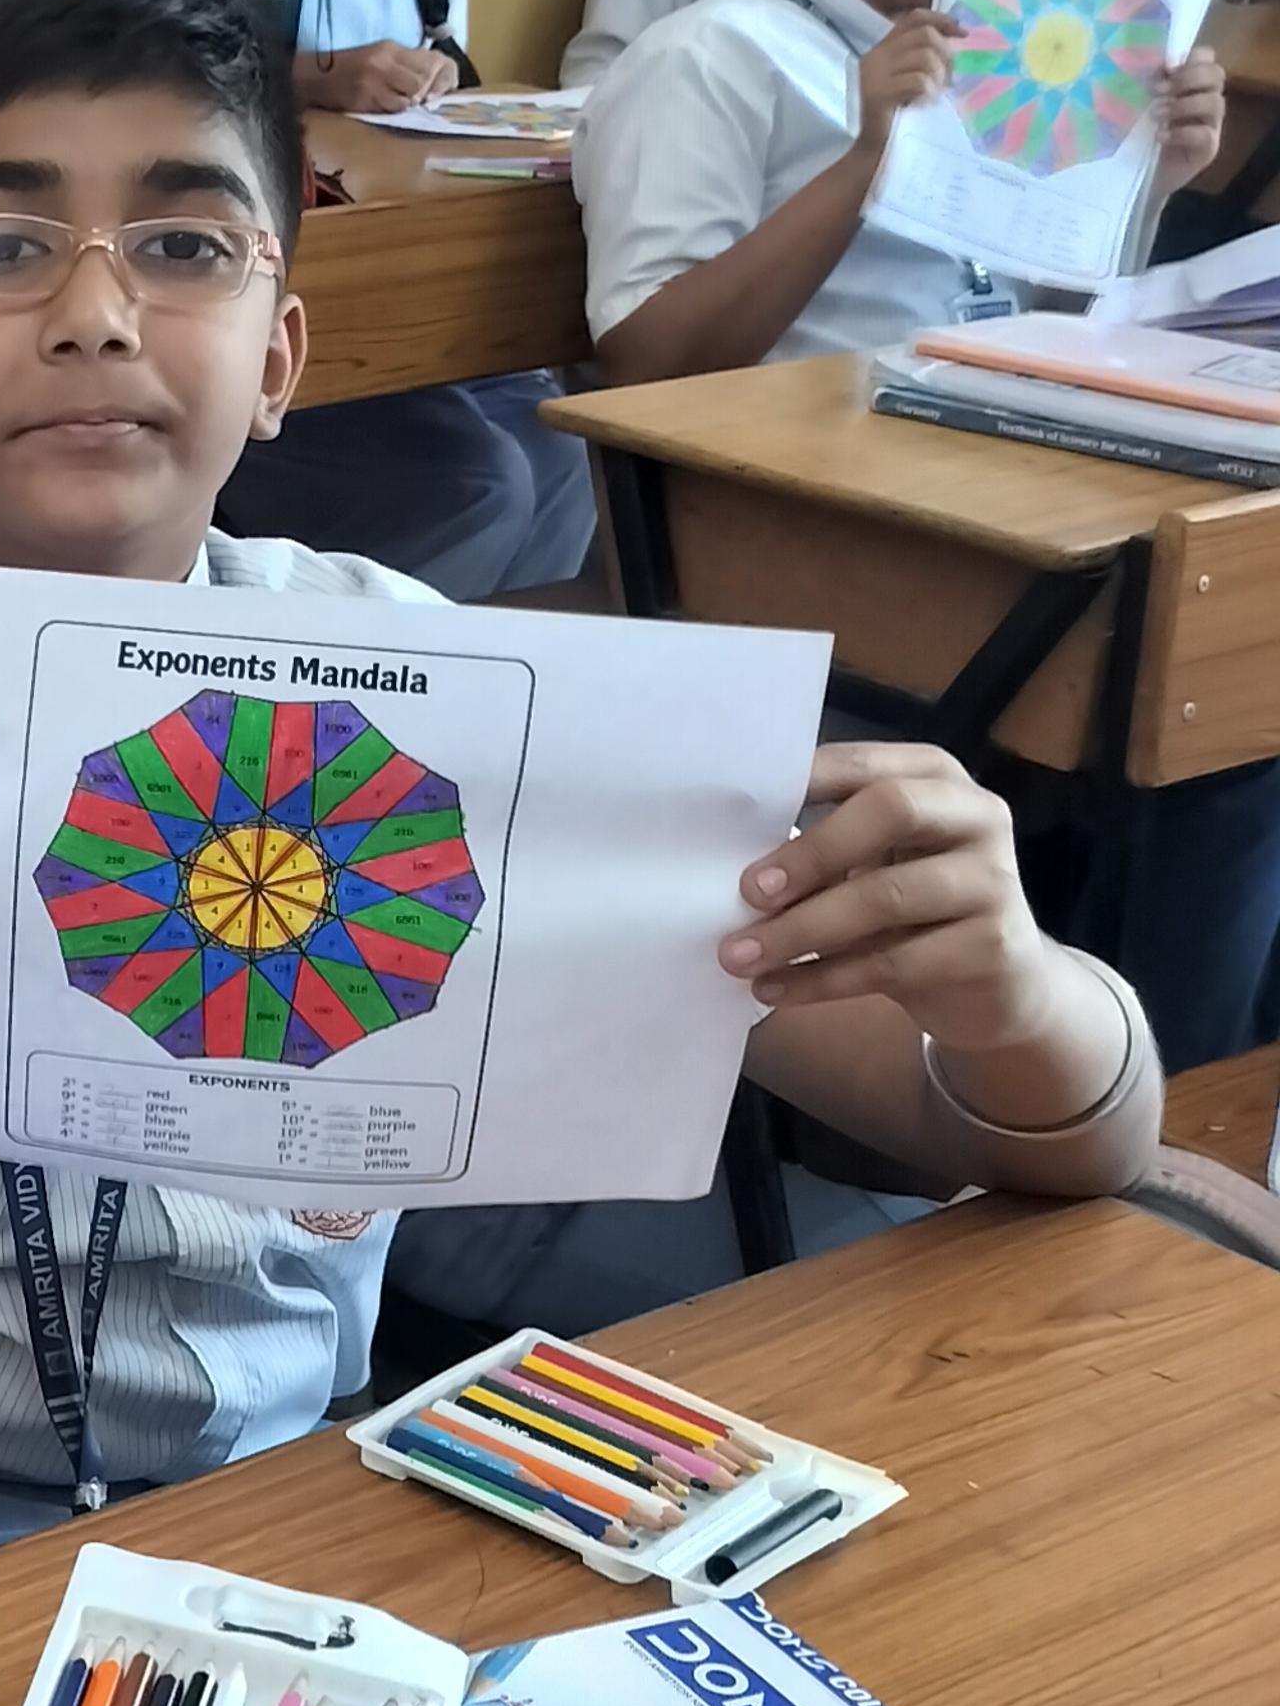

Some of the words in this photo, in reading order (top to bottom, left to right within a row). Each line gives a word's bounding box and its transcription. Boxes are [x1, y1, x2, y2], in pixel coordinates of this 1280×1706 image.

[117, 639, 277, 679] Exponents
[290, 656, 429, 696] Mandala
[188, 1073, 291, 1093] EXPONENTS
[369, 1104, 402, 1118] blue
[366, 1118, 416, 1134] purple
[365, 1131, 391, 1144] red
[363, 1146, 408, 1159] green
[362, 1157, 411, 1172] yellow
[88, 1187, 121, 1301] AMRITA
[27, 1239, 60, 1342] AMRITA
